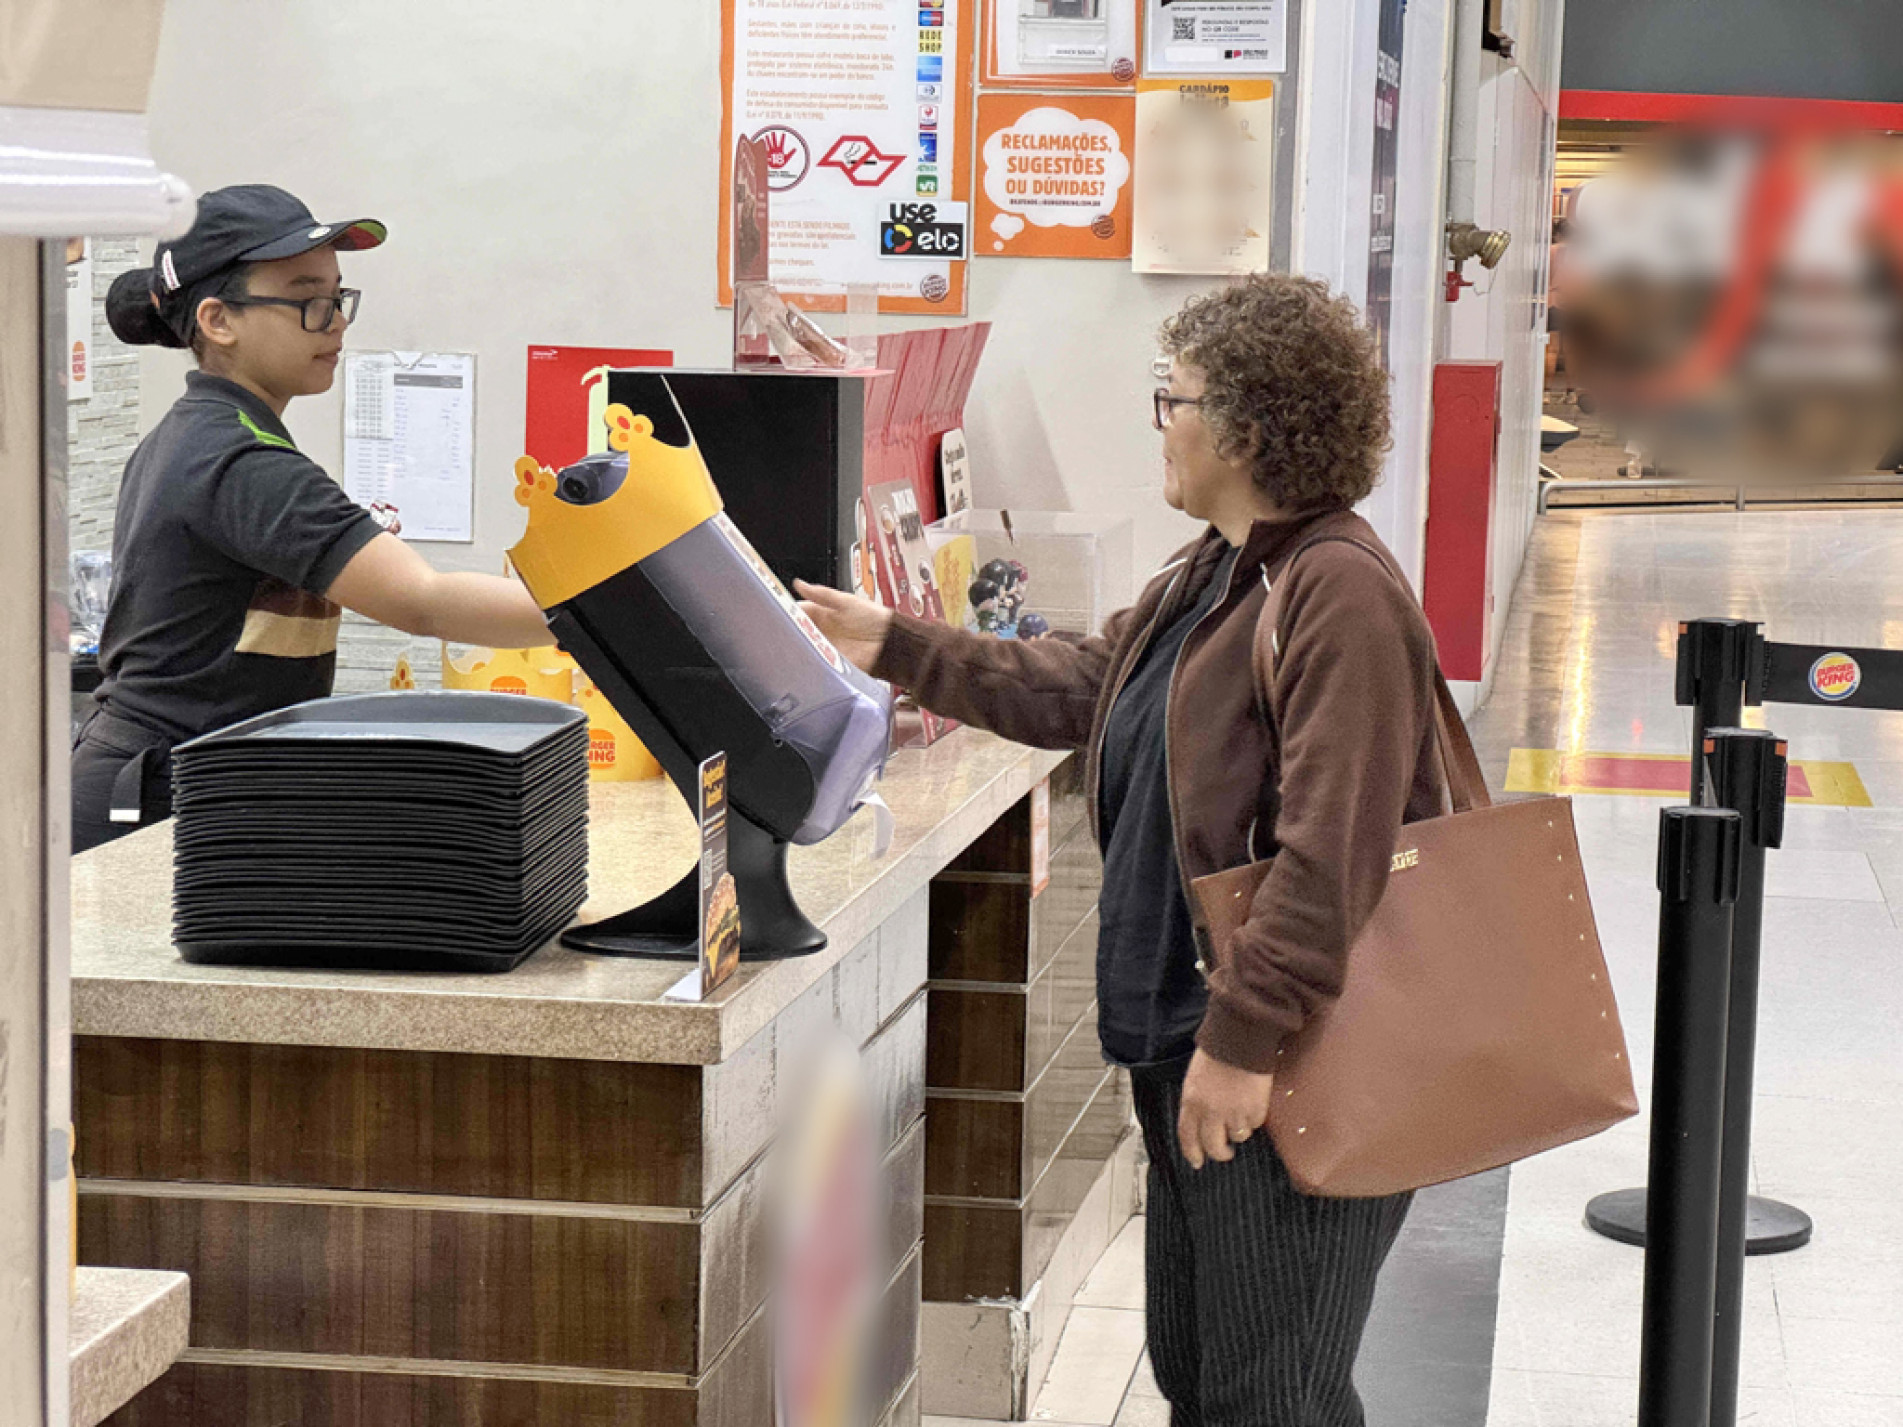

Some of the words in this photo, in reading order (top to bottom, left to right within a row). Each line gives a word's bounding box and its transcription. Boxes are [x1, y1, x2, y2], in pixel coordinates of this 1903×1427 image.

[1001, 132, 1112, 156] RECLAMAÇÕES,
[1006, 154, 1106, 176] SUGESTÕES
[1005, 179, 1027, 194] OU
[1033, 176, 1106, 196] DÚVIDAS?
[889, 202, 937, 223] use
[917, 227, 960, 251] elo
[1816, 662, 1855, 677] BURGER
[1816, 672, 1855, 689] KING
[588, 750, 616, 762] ING
